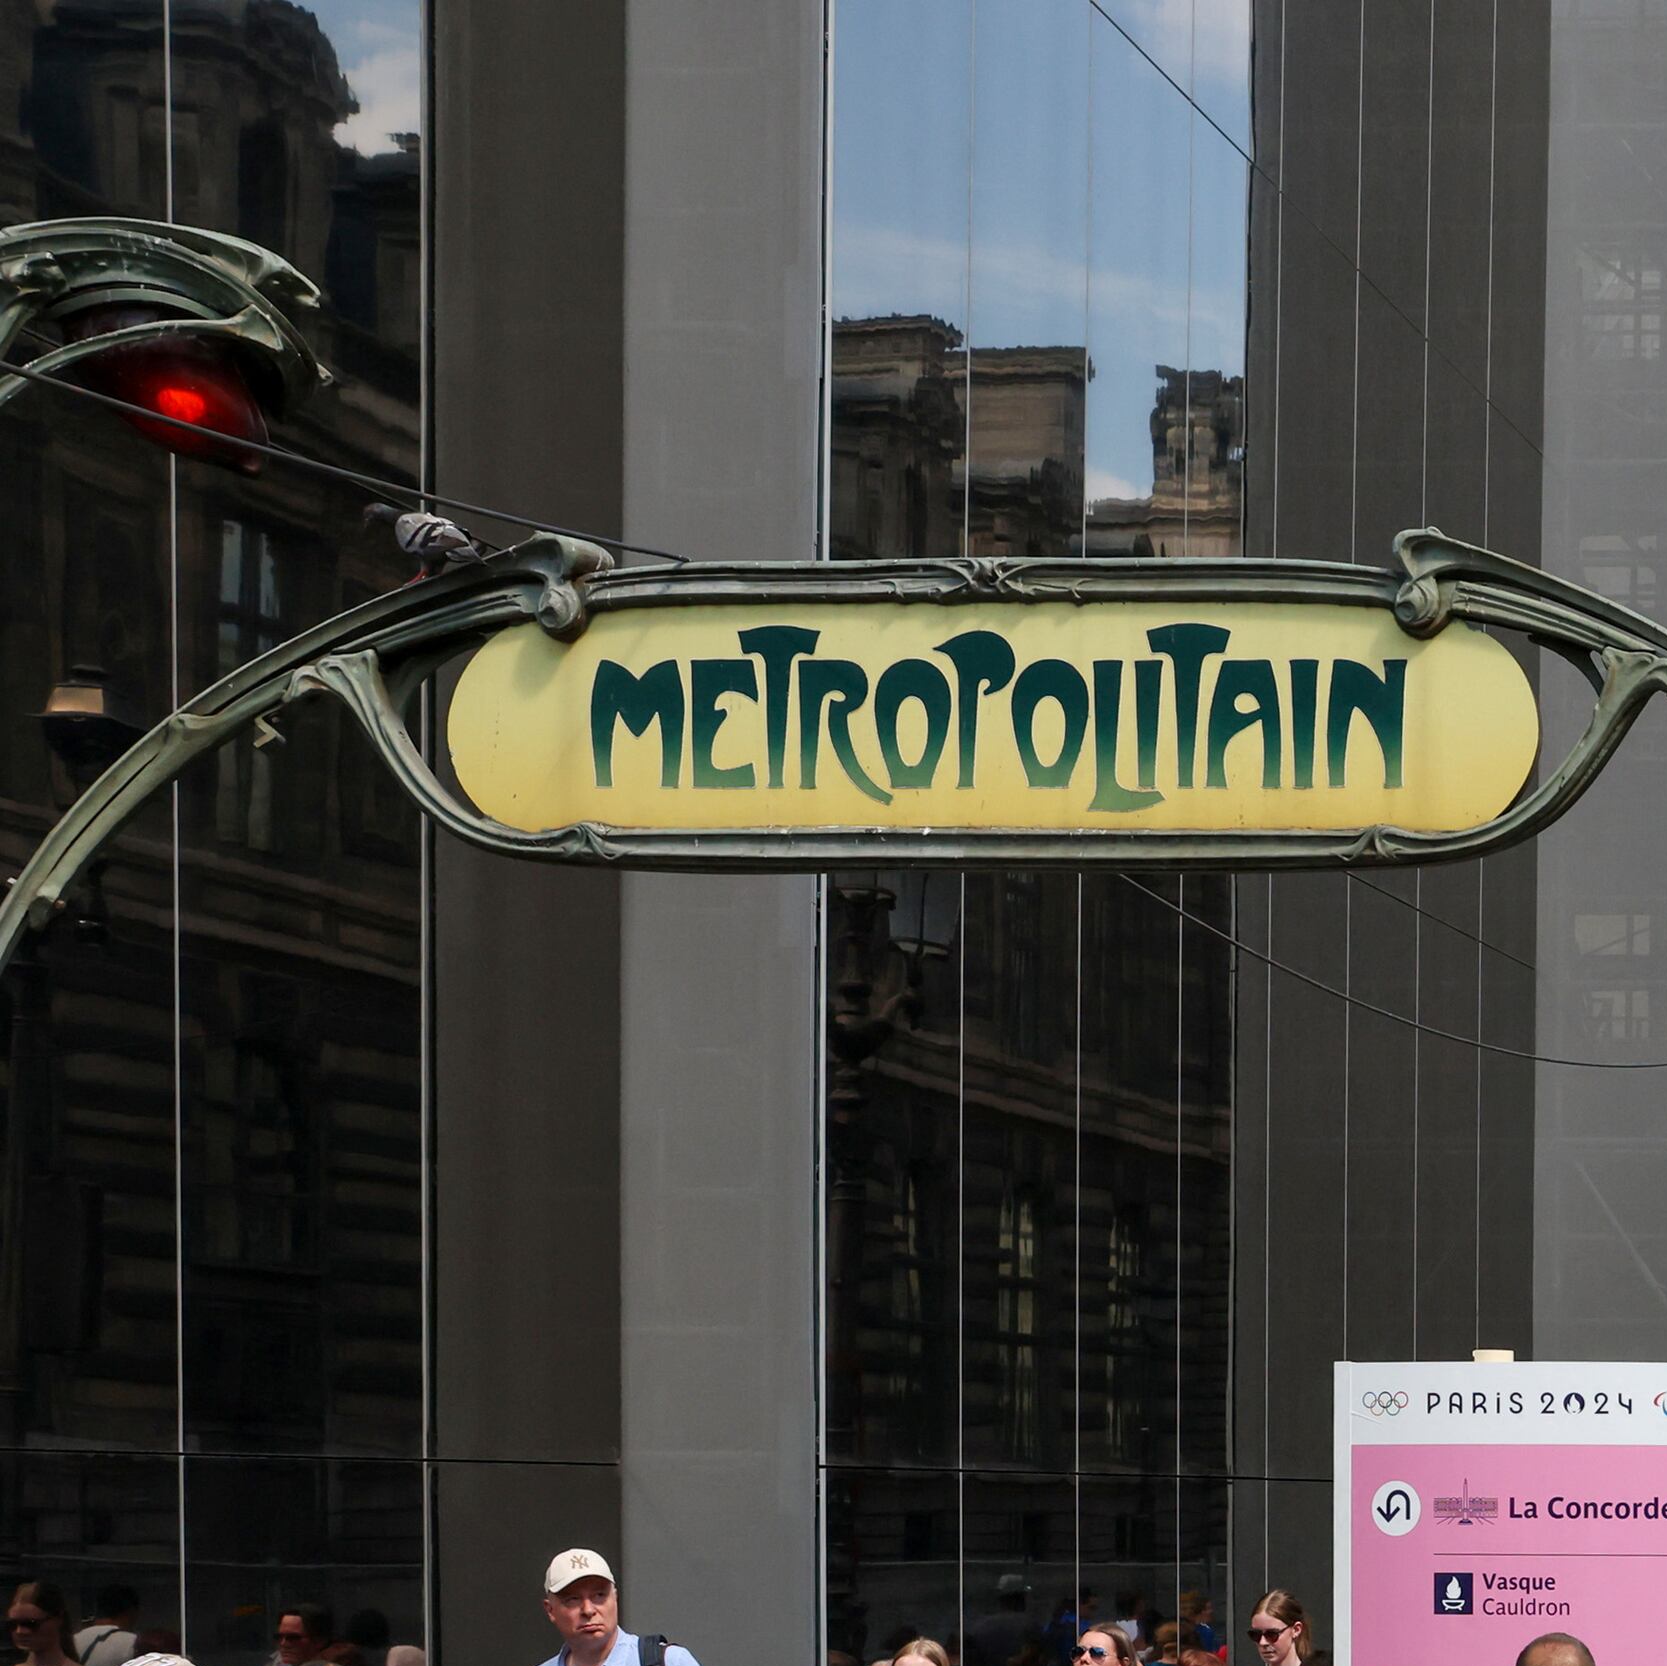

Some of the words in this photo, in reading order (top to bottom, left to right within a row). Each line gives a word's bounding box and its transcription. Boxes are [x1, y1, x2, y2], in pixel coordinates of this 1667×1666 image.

[589, 622, 1408, 814] METROPOLITAIN
[1540, 1391, 1633, 1415] 2024
[1508, 1496, 1538, 1520] La
[1482, 1573, 1556, 1595] Vasque
[1482, 1597, 1571, 1616] Cauldron
